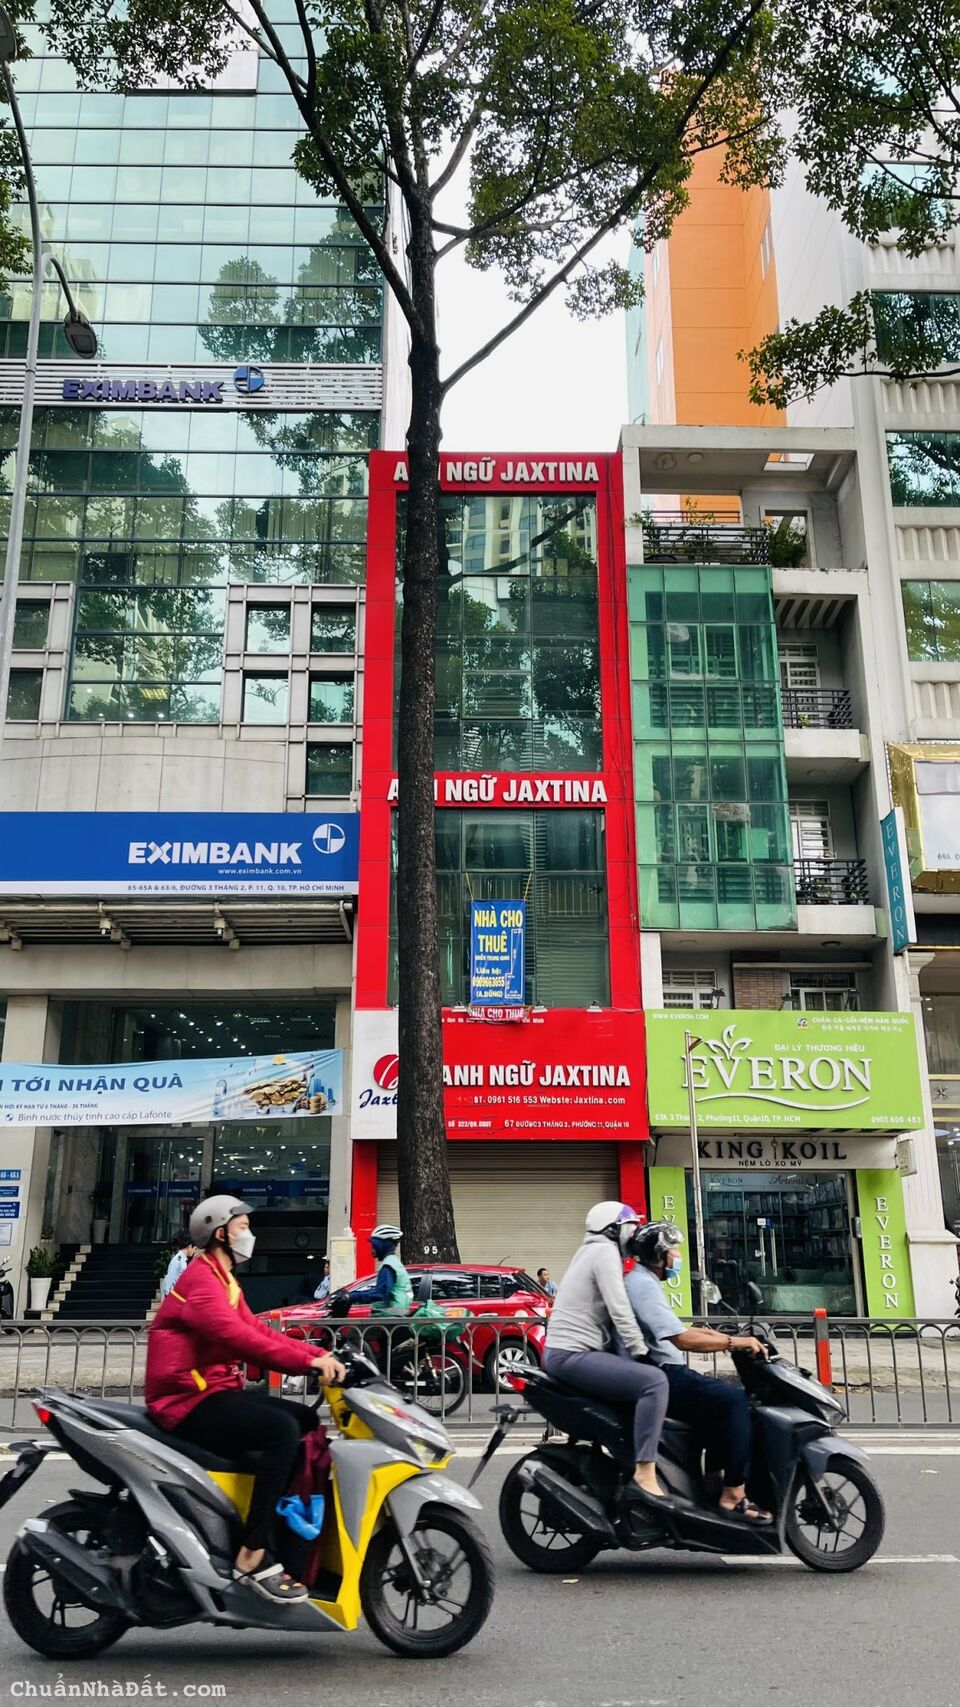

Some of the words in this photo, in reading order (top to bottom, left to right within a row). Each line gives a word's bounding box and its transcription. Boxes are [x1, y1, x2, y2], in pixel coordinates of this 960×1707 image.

[62, 379, 224, 402] EXIMBANK
[446, 457, 496, 482] NGỮ
[500, 461, 599, 482] JAXTINA
[445, 774, 497, 802] NGỮ
[503, 779, 608, 803] JAXTINA
[128, 841, 303, 865] EXIMBANK
[218, 867, 302, 875] www.eximbank.com.vn
[886, 822, 905, 944] EVERON
[474, 906, 497, 928] NHÀ
[500, 909, 524, 928] CHO
[477, 931, 508, 953] THUÊ
[487, 1009, 503, 1019] CHO
[11, 1076, 51, 1092] TỚI
[58, 1076, 126, 1095] NHẬN
[133, 1073, 183, 1092] QUÀ
[443, 1065, 483, 1087] ANH
[489, 1060, 537, 1087] NGỮ
[539, 1065, 631, 1087] JAXTINA
[681, 1056, 872, 1091] EVERON
[487, 1096, 505, 1104] 0961
[507, 1096, 521, 1104] 516
[523, 1096, 538, 1104] 553
[140, 1110, 172, 1119] Lafonte
[504, 1119, 515, 1128] 67
[698, 1141, 763, 1159] KING
[781, 1142, 847, 1160] KOIL
[875, 1197, 898, 1309] EVERON
